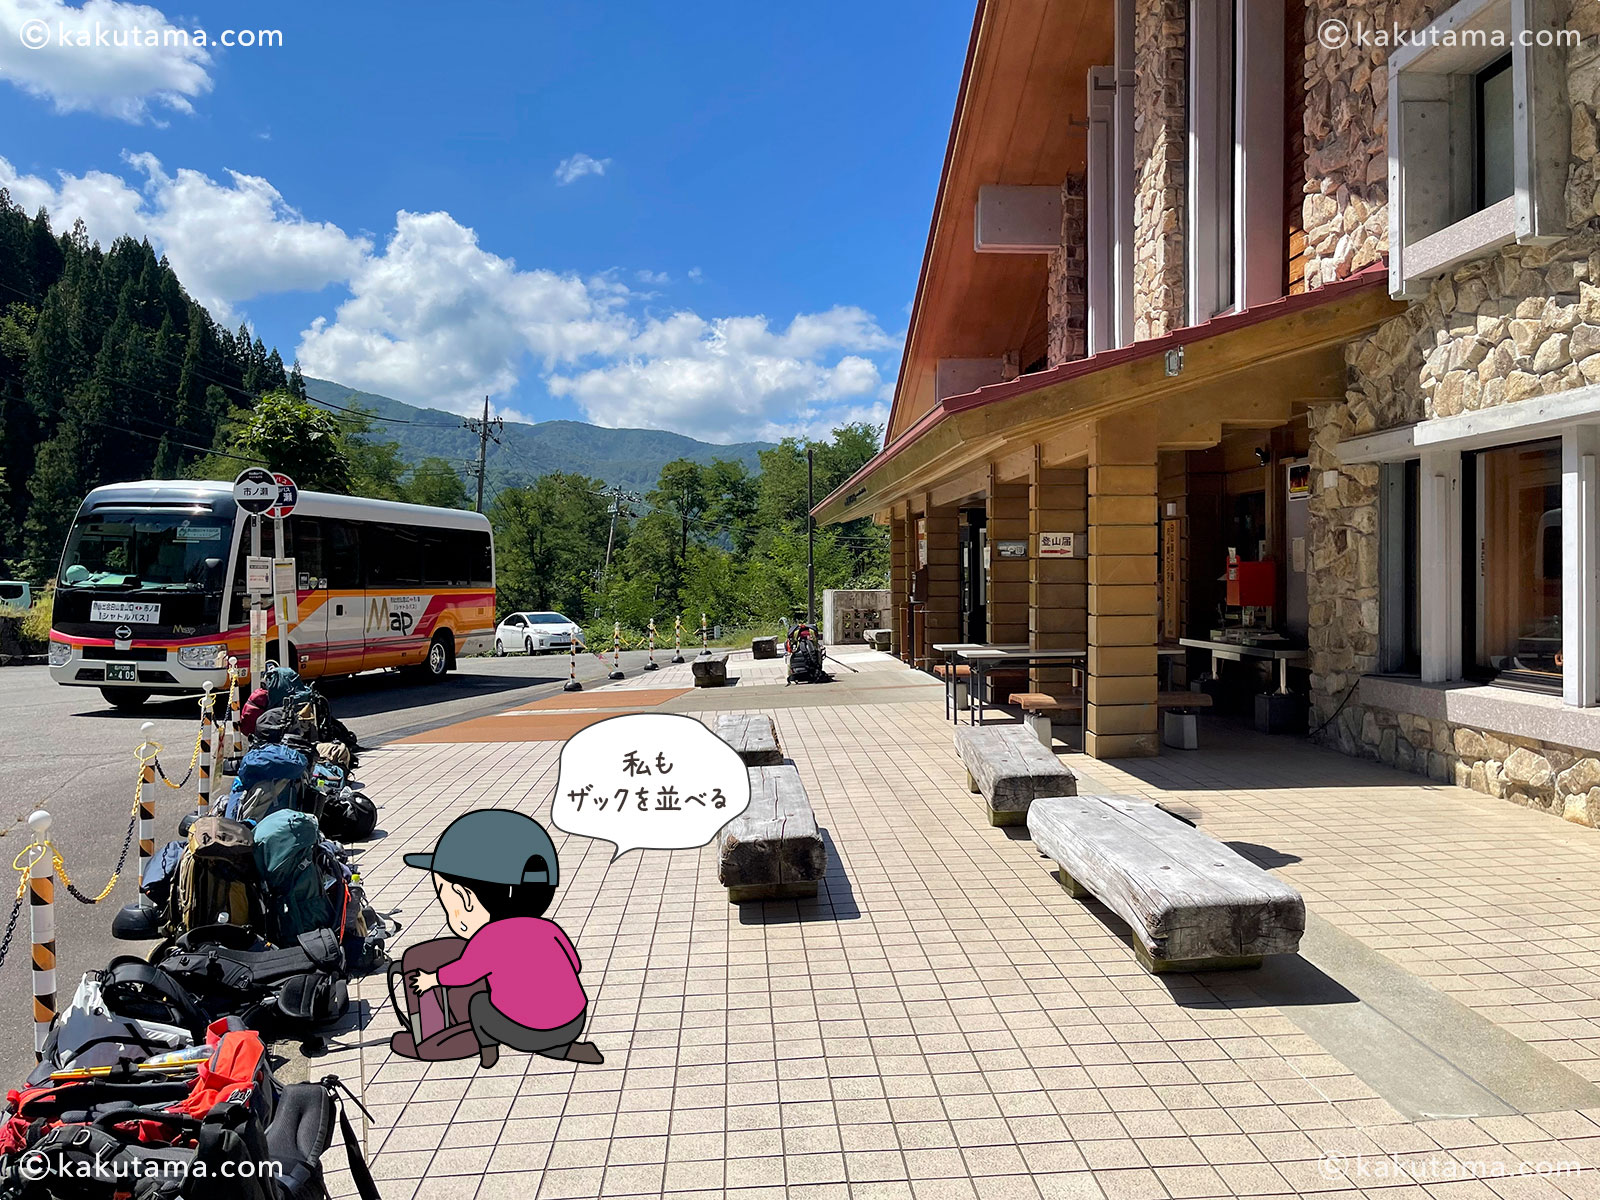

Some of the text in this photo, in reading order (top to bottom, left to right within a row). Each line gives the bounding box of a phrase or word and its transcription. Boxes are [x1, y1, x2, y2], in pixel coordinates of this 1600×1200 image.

[243, 487, 269, 496] 市ノ瀬
[1041, 536, 1072, 547] 登山届
